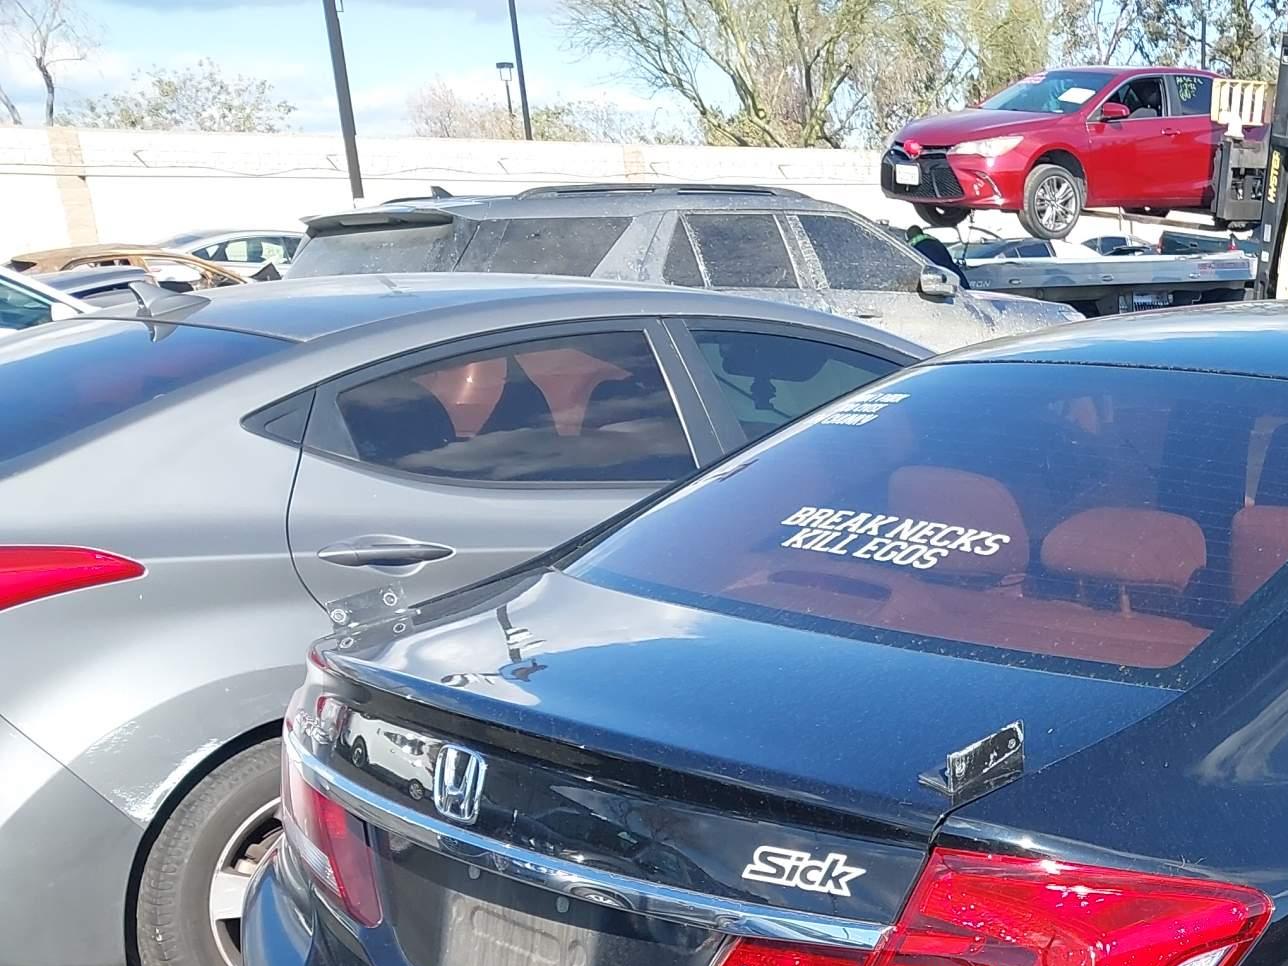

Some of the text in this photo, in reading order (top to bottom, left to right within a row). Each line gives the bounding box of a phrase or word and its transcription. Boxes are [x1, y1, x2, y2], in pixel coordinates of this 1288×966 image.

[1267, 150, 1281, 203] HYSTER
[781, 506, 1011, 556] BREAK NECKS
[781, 527, 949, 570] KILL EGOS
[741, 845, 867, 897] Sick
